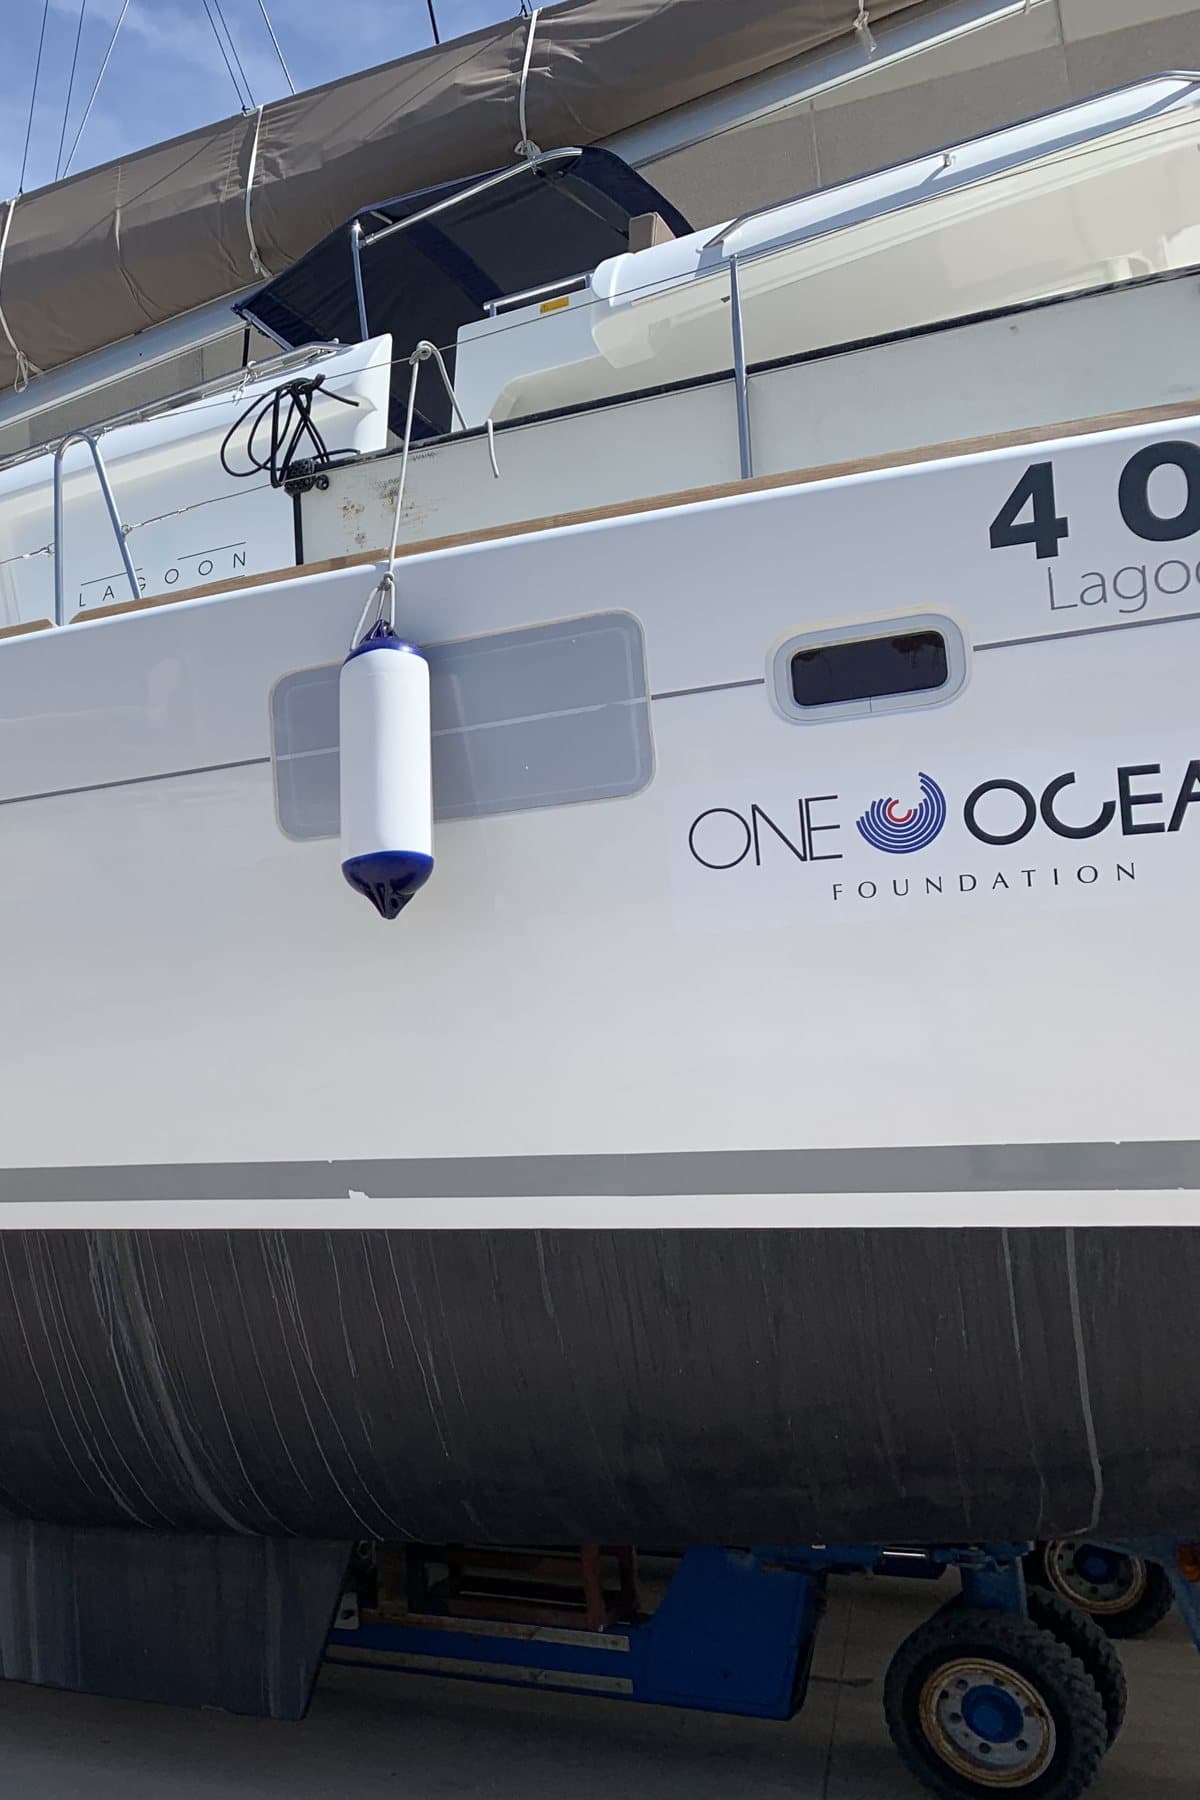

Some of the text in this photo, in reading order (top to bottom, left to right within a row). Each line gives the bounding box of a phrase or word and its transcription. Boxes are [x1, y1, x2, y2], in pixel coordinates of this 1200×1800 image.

[79, 551, 246, 607] LAGOON
[1047, 559, 1200, 613] Lago
[689, 795, 843, 870] ONE
[832, 862, 1136, 900] FOUNDATION
